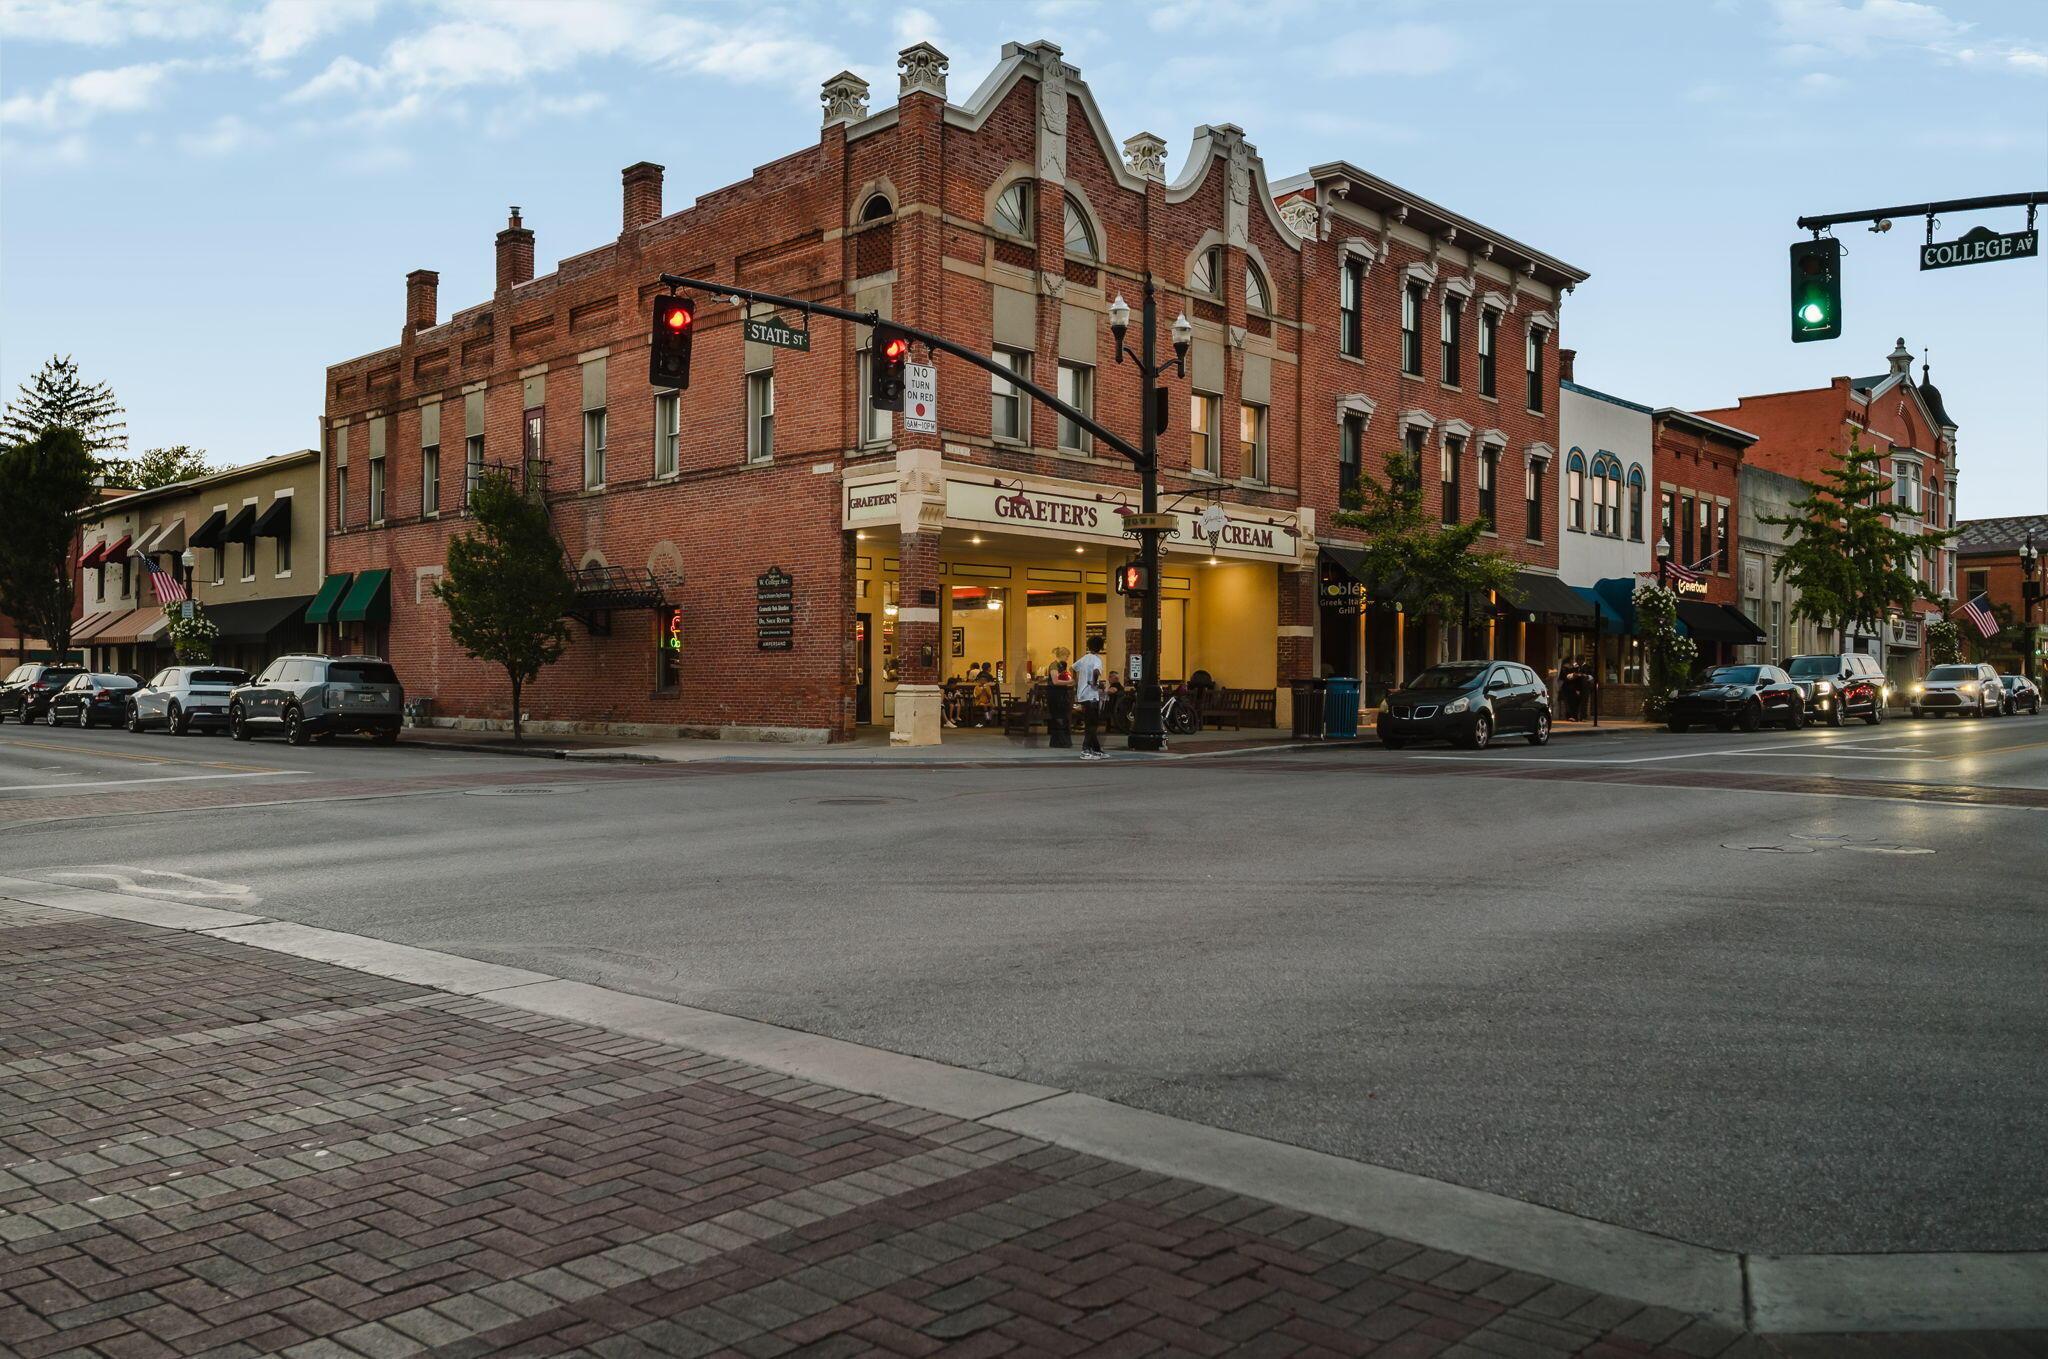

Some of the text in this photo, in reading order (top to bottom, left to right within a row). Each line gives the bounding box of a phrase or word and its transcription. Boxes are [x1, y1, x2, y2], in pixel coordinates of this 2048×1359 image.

[1924, 238, 2033, 265] COLLEGE AV
[751, 324, 803, 345] STATE ST
[913, 367, 928, 378] NO
[912, 380, 930, 390] TURN
[907, 390, 934, 402] ON RED
[850, 493, 897, 509] GRAETER'S
[995, 495, 1098, 528] GRAETER'S
[1221, 524, 1274, 548] CREAM
[1685, 582, 1708, 594] everbowl
[1320, 599, 1343, 607] Greek
[1339, 606, 1356, 614] Grill
